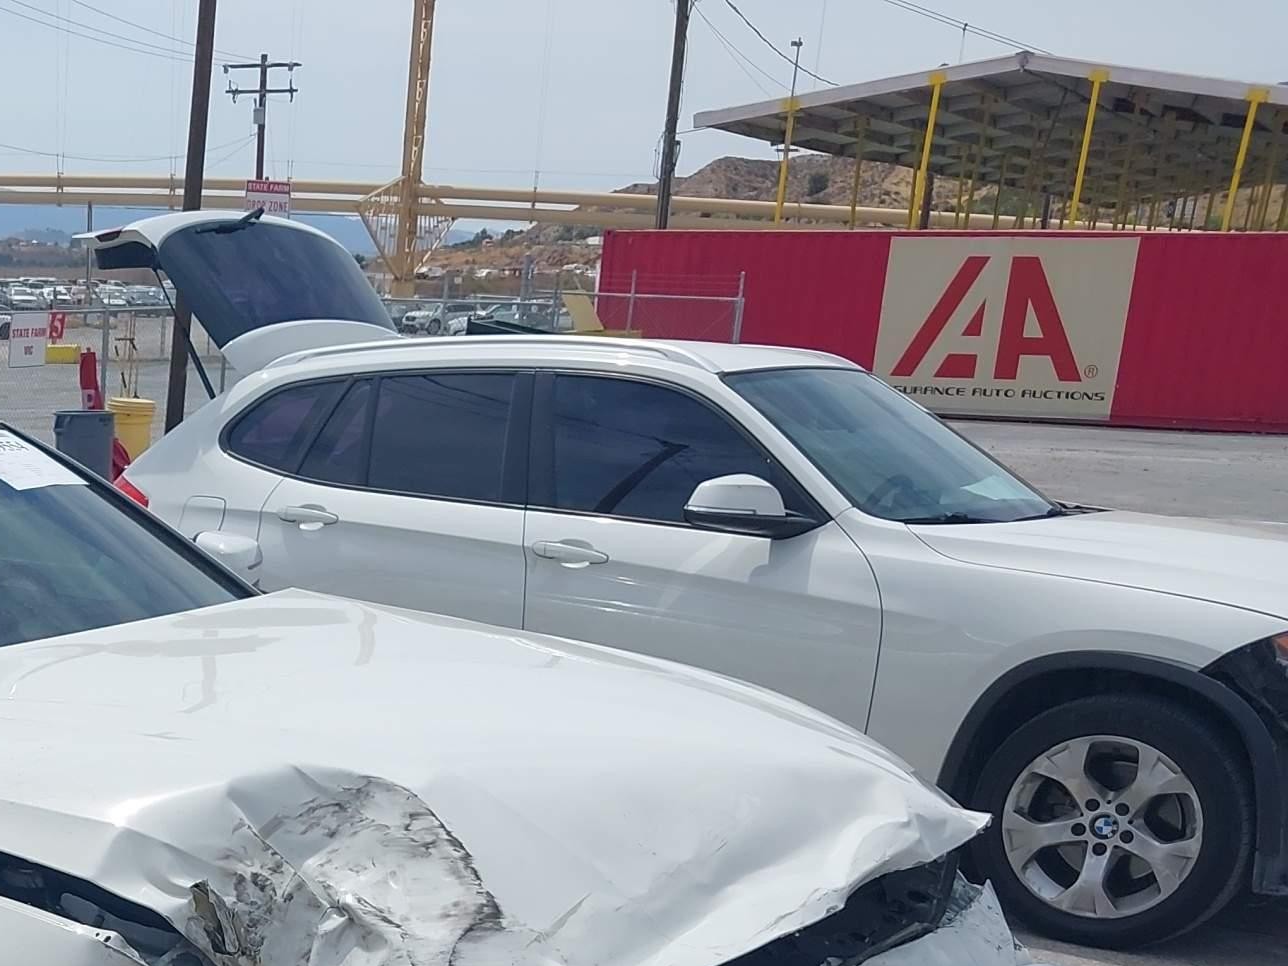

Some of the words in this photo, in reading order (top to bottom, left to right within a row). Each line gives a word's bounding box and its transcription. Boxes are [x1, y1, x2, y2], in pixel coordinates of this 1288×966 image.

[269, 200, 288, 212] ZONE
[51, 313, 62, 337] 5
[12, 328, 30, 338] STATE
[893, 385, 967, 397] SURANCE
[972, 387, 1016, 399] AUTO
[1020, 388, 1105, 401] AUCTIONS
